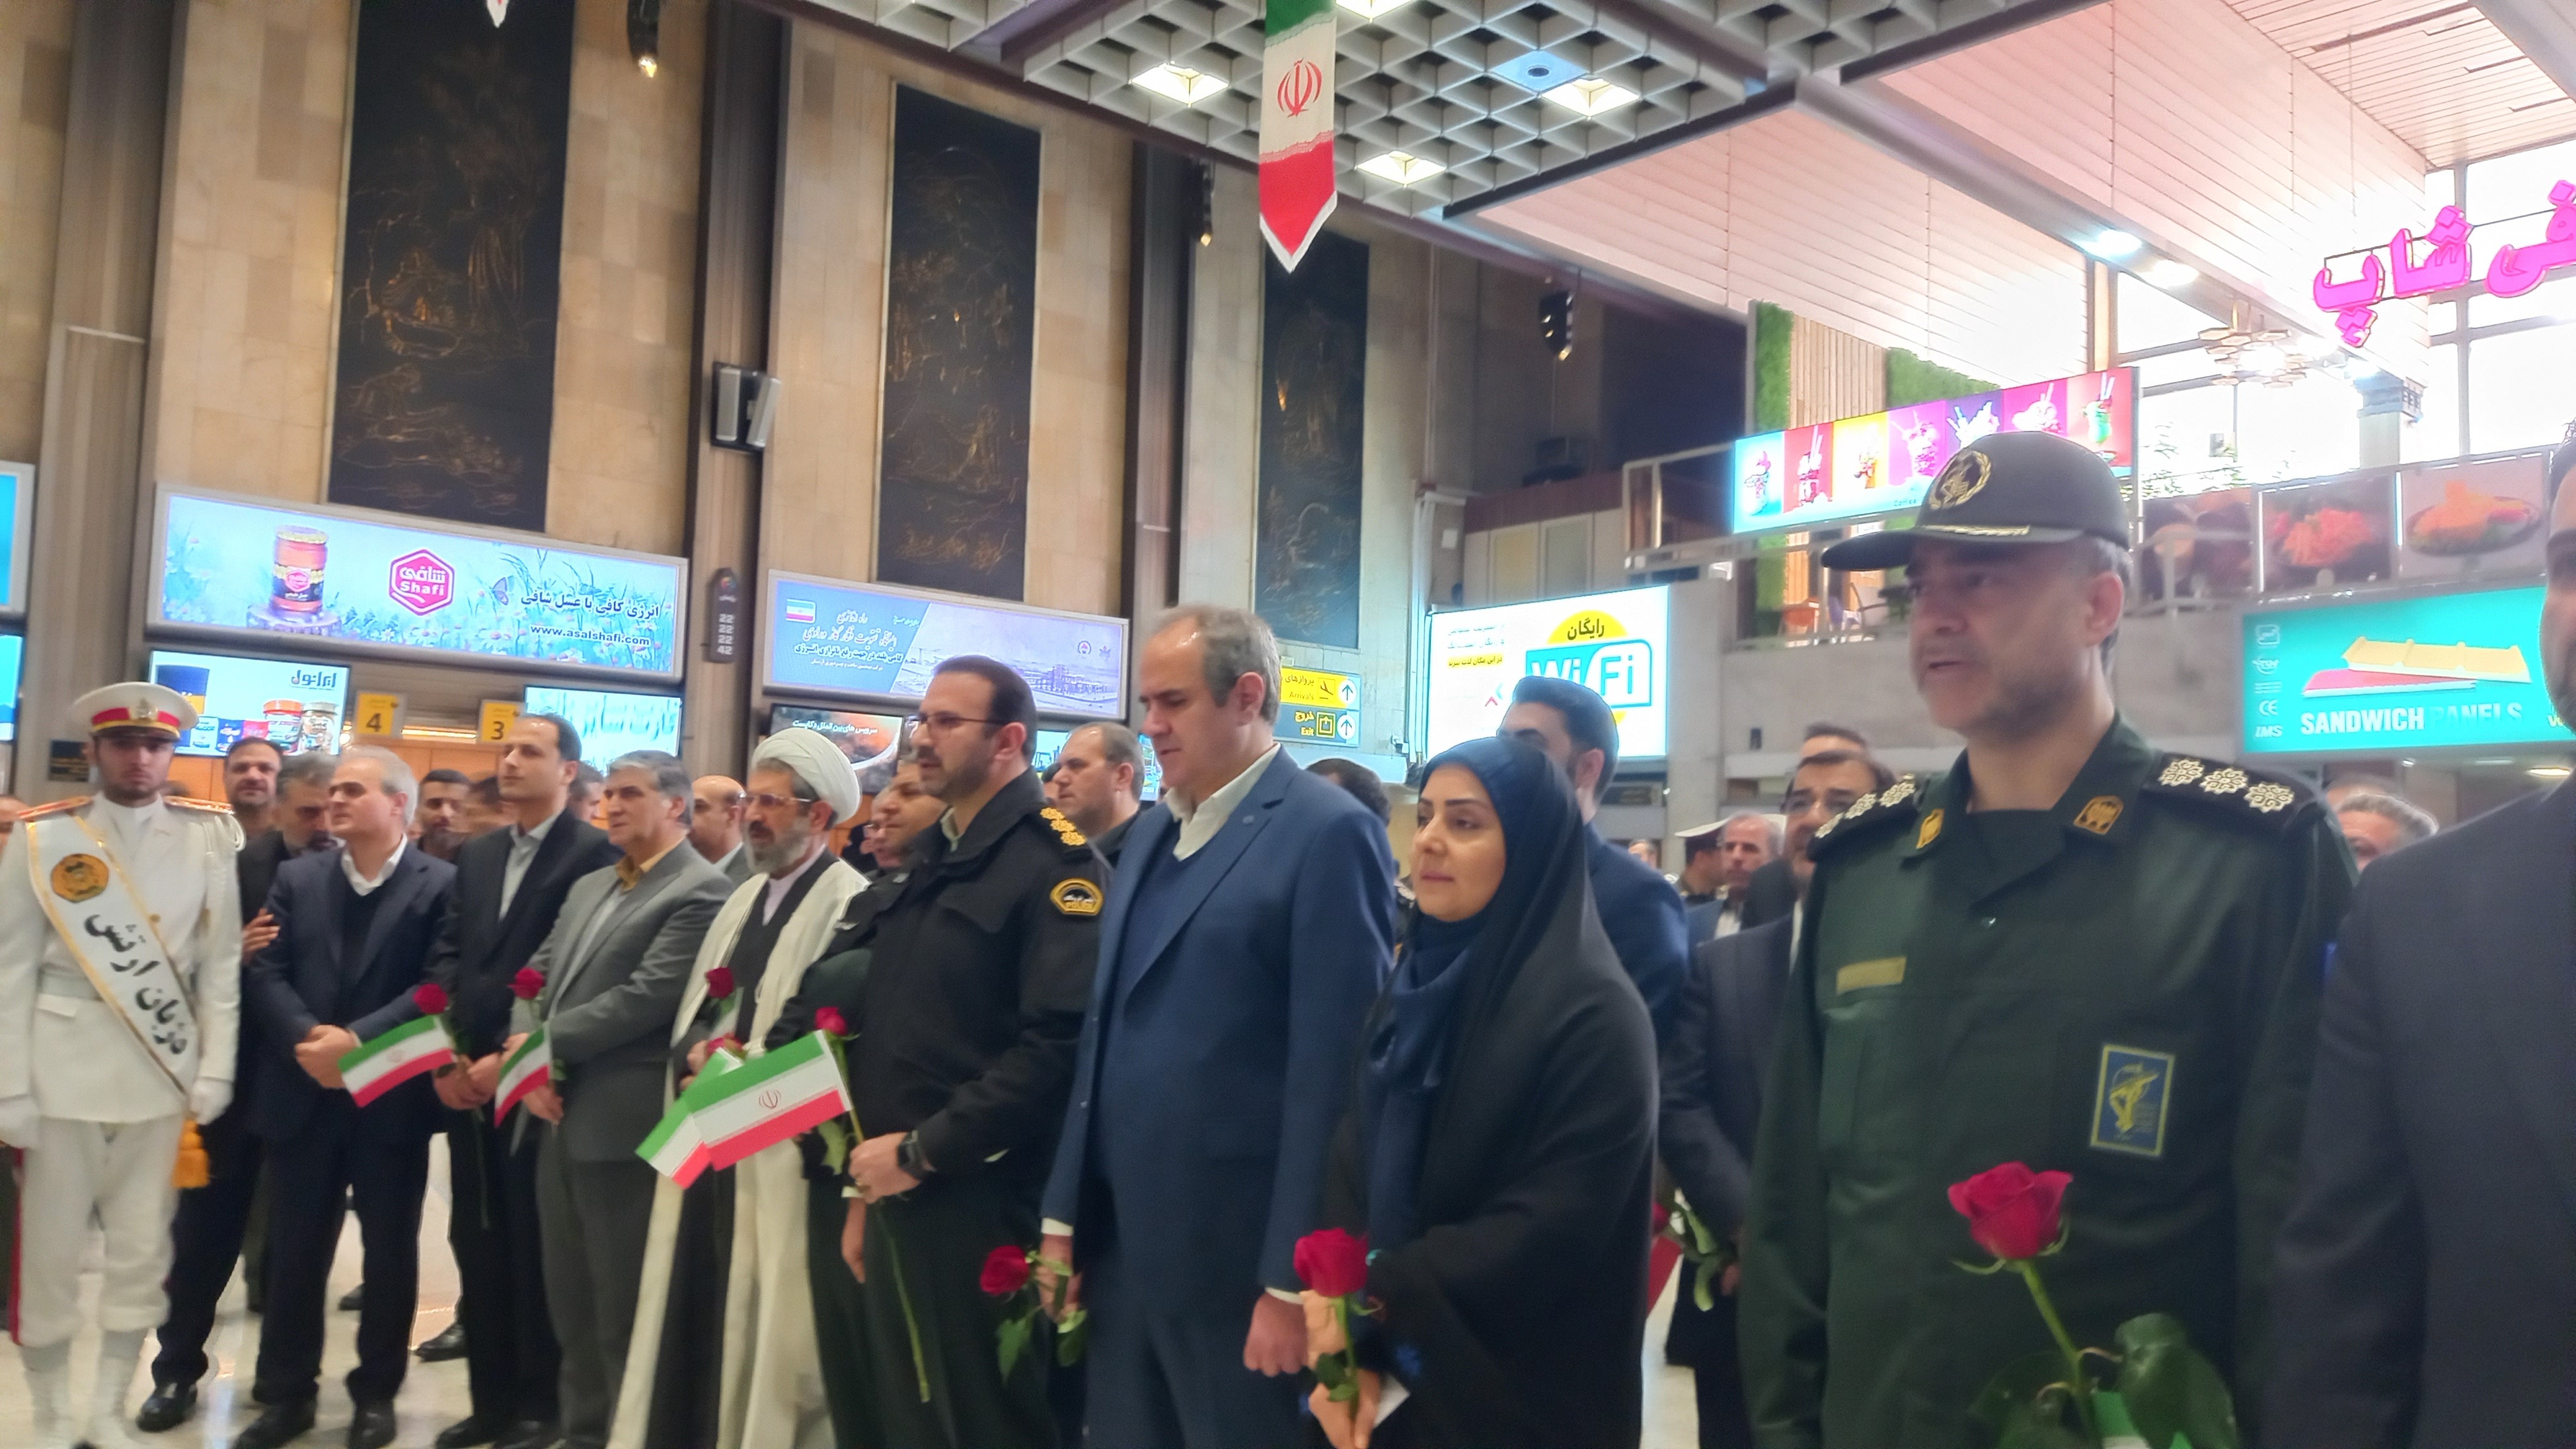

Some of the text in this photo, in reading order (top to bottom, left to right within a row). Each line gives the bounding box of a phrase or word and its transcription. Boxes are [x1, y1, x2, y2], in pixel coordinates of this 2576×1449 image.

[399, 565, 446, 584] شافی
[400, 581, 444, 596] Shafi
[521, 590, 659, 619] انرژی کافی با عسل شافی
[719, 614, 734, 623] 22
[531, 625, 650, 645] www.asalshafi.com
[719, 623, 733, 634] 22
[1567, 618, 1605, 640] رایگان
[718, 634, 733, 644] 22
[717, 645, 733, 656] 42
[291, 669, 337, 688] ایرانول
[1289, 692, 1314, 701] Arrivals
[366, 714, 381, 732] 4
[1295, 711, 1314, 723] خروج
[2300, 706, 2425, 735] SANDWICH
[2428, 702, 2523, 729] PANELS
[491, 721, 504, 740] 3
[1301, 726, 1314, 736] Exit
[2255, 725, 2283, 737] IMS
[84, 914, 160, 977] ارتش
